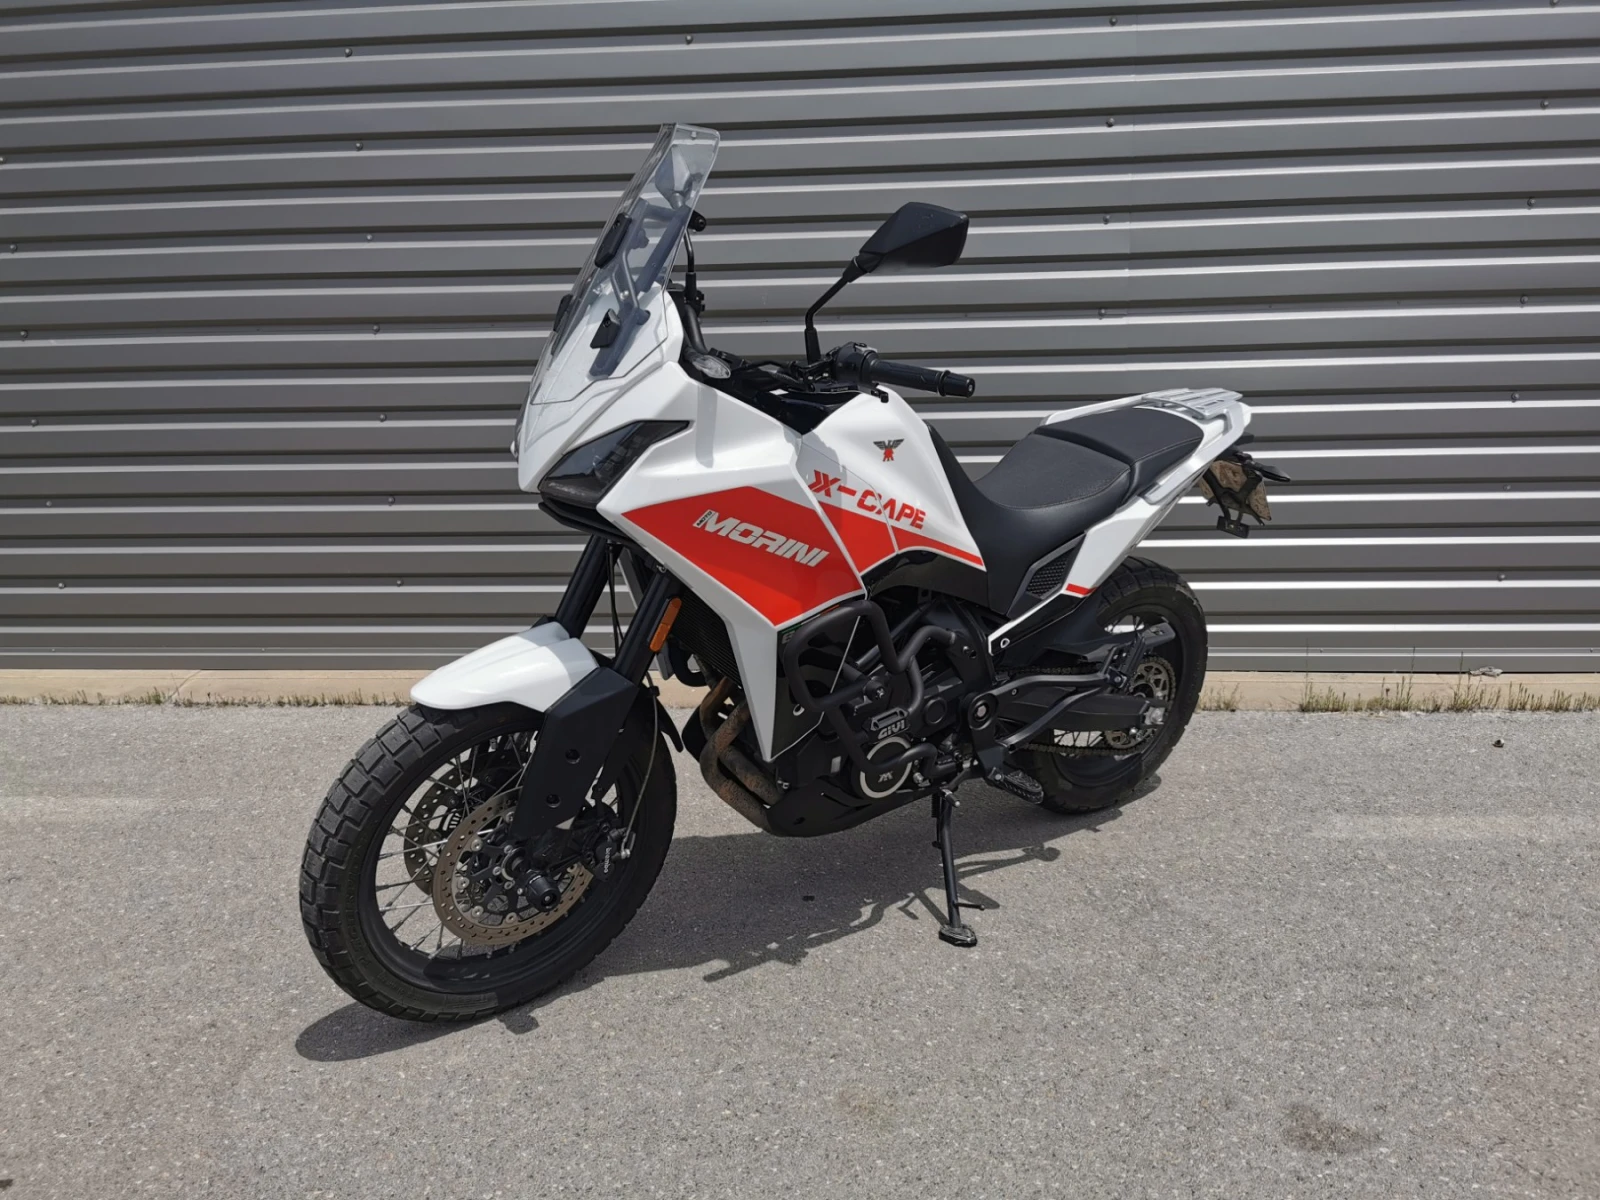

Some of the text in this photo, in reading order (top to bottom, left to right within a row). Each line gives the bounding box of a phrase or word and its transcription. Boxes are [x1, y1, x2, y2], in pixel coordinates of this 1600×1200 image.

[808, 469, 926, 530] X-CAPE
[704, 511, 830, 567] MORINI
[877, 719, 906, 740] GIVI
[603, 847, 612, 874] brembo
